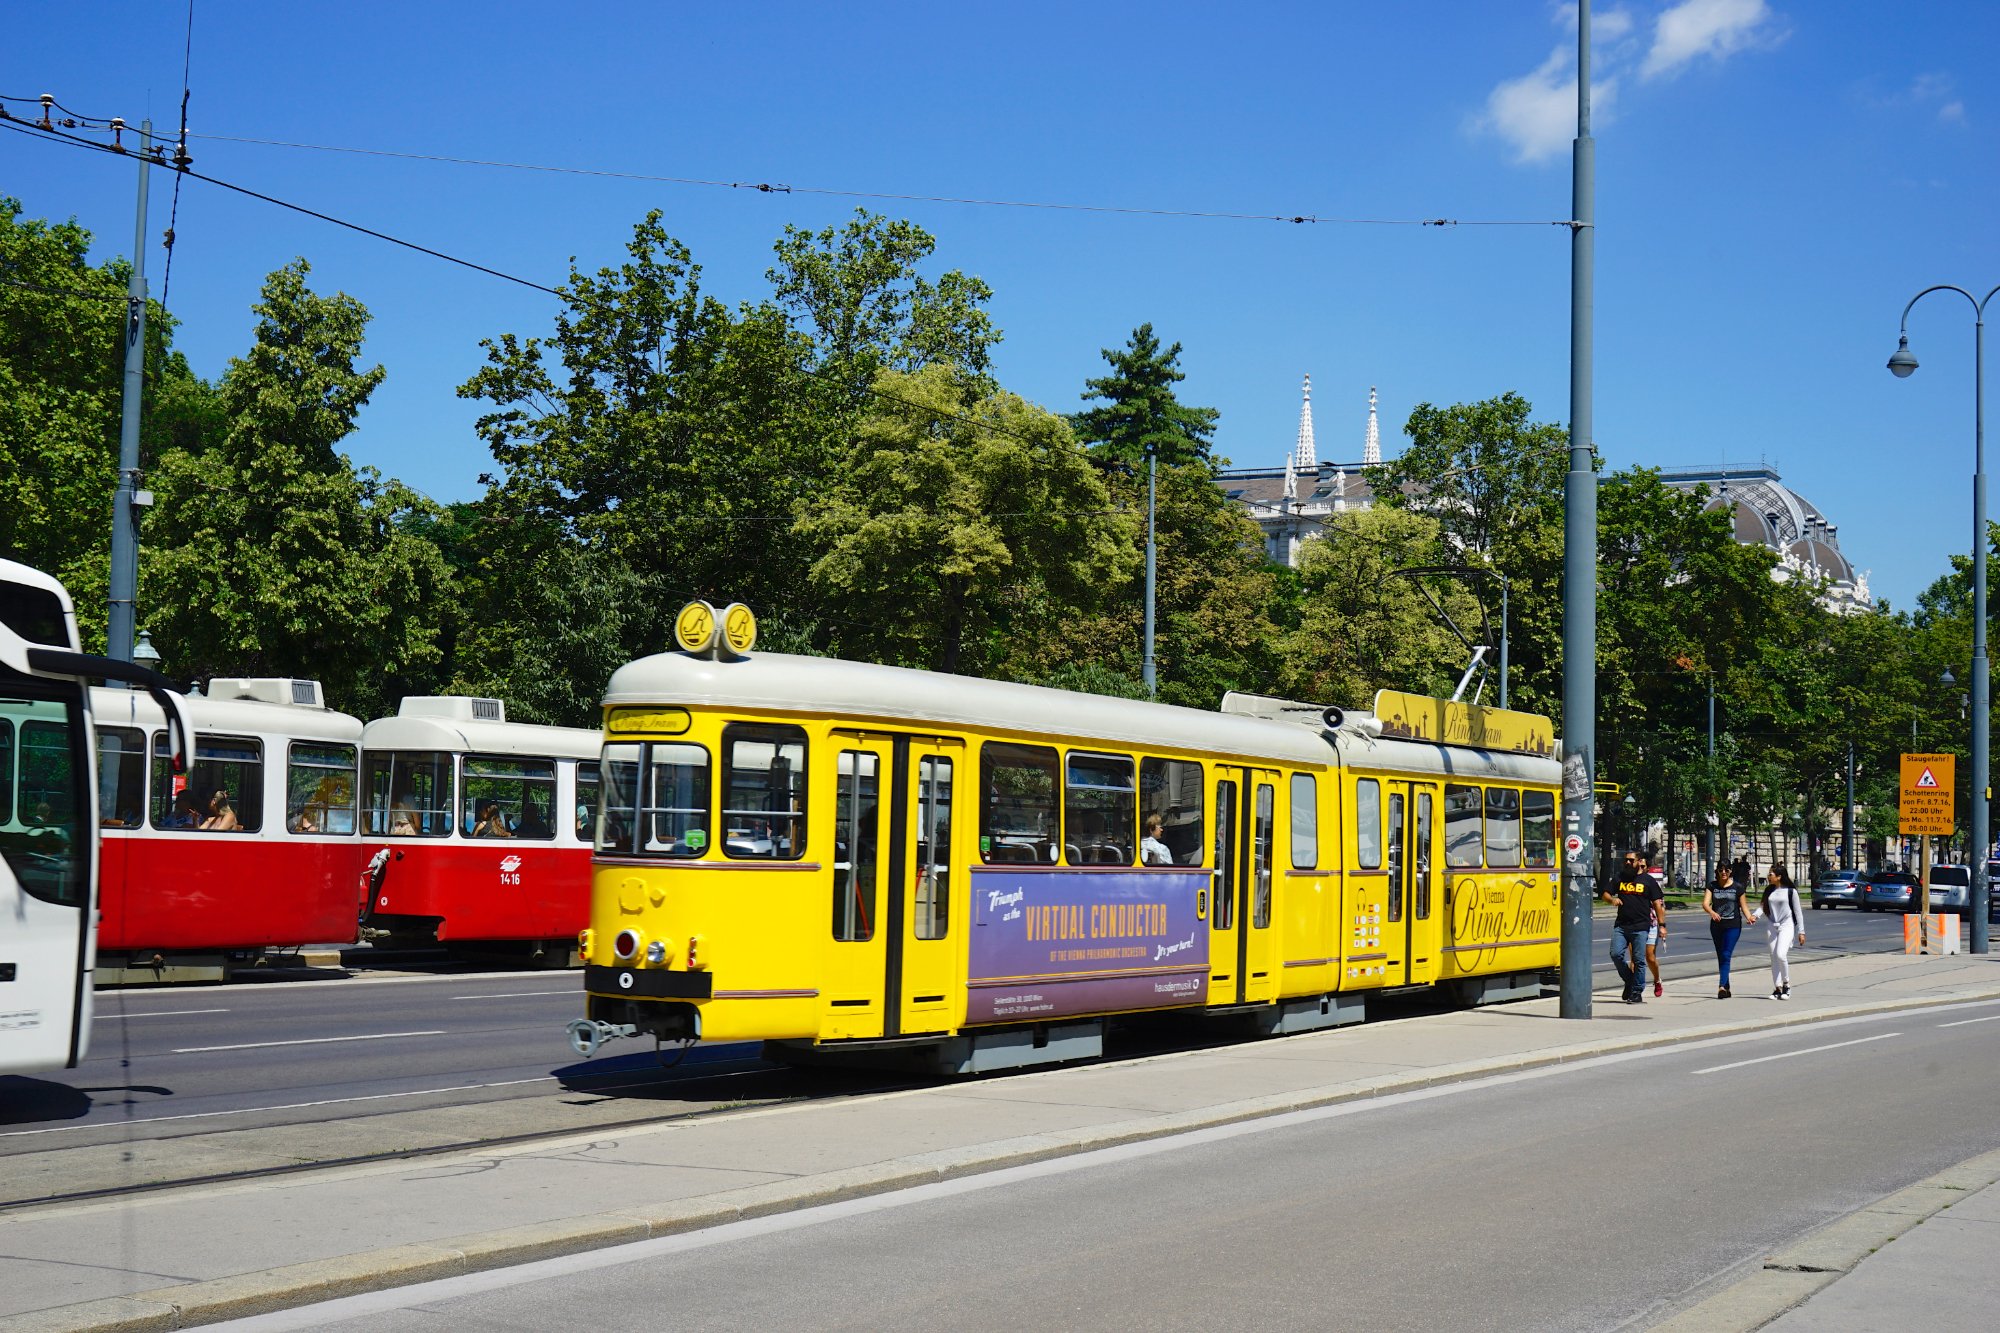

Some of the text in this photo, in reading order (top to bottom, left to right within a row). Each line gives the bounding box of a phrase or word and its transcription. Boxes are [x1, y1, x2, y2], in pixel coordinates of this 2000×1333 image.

[1442, 701, 1502, 745] Ring Tram
[1906, 755, 1950, 763] Staugefahr!
[1904, 789, 1950, 797] Schottenring
[500, 873, 520, 885] 1416
[1619, 881, 1645, 893] KGB
[988, 886, 1024, 912] Triumph
[1483, 886, 1505, 904] Vienna
[1002, 907, 1021, 921] as the
[1025, 904, 1167, 941] VIRTUAL CONDUCTOR
[1451, 877, 1551, 973] Ring Tram
[1166, 943, 1179, 957] your
[1178, 932, 1195, 950] turn!
[1049, 951, 1057, 962] OF
[1058, 950, 1067, 961] THE
[1068, 949, 1086, 961] VIENNA
[1121, 946, 1147, 958] ORCHESTRA
[1154, 979, 1192, 993] hausdermusik
